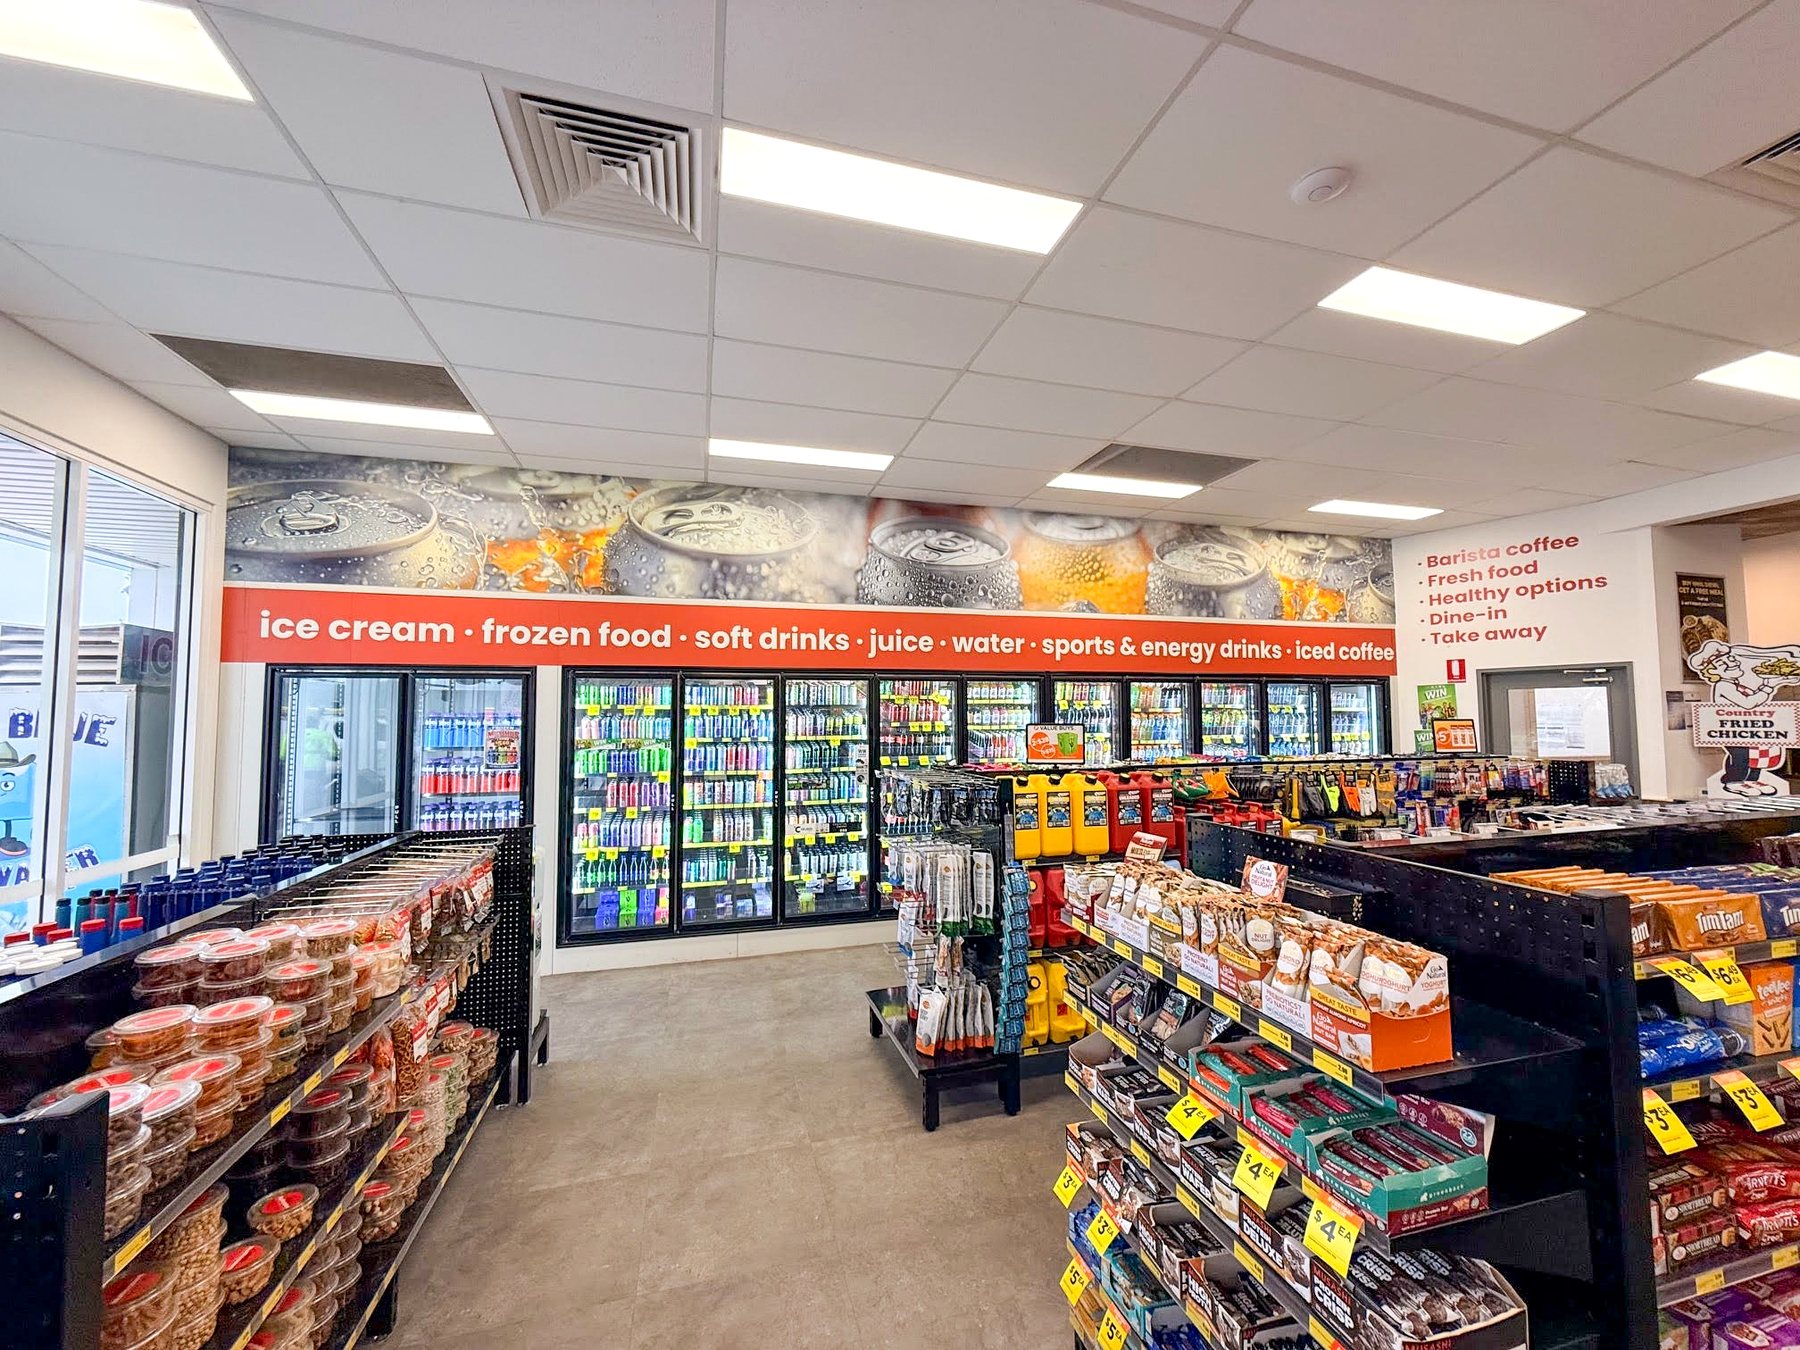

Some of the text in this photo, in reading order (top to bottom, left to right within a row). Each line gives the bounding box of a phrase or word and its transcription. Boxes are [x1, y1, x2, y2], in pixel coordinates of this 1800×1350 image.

[1426, 536, 1579, 568] Barista coffee
[1428, 560, 1538, 587] Fresh food
[1429, 576, 1608, 606] Healthy options
[1430, 606, 1507, 625] Dine-in
[260, 609, 1395, 664] ice cream frozen food soft drinks juice water sports & energy drinks iced coffee
[1430, 626, 1548, 645] Take away
[1425, 687, 1447, 701] WIN
[1715, 709, 1775, 718] Country
[1719, 719, 1775, 729] FRIED
[1707, 730, 1789, 740] CHICKEN
[1421, 980, 1446, 989] YOGHURT
[1317, 992, 1358, 1017] GREAT TASTE
[1312, 1015, 1337, 1035] Natural
[1196, 1110, 1207, 1121] EA
[1262, 1167, 1275, 1181] EA
[1428, 1184, 1464, 1199] greenback
[1338, 1225, 1352, 1243] EA
[1242, 1223, 1284, 1268] DELUXE
[1349, 1264, 1378, 1290] RISP
[1356, 1254, 1393, 1282] CRISP
[1313, 1274, 1352, 1316] PROTEIN
[1314, 1285, 1355, 1330] CRISP
